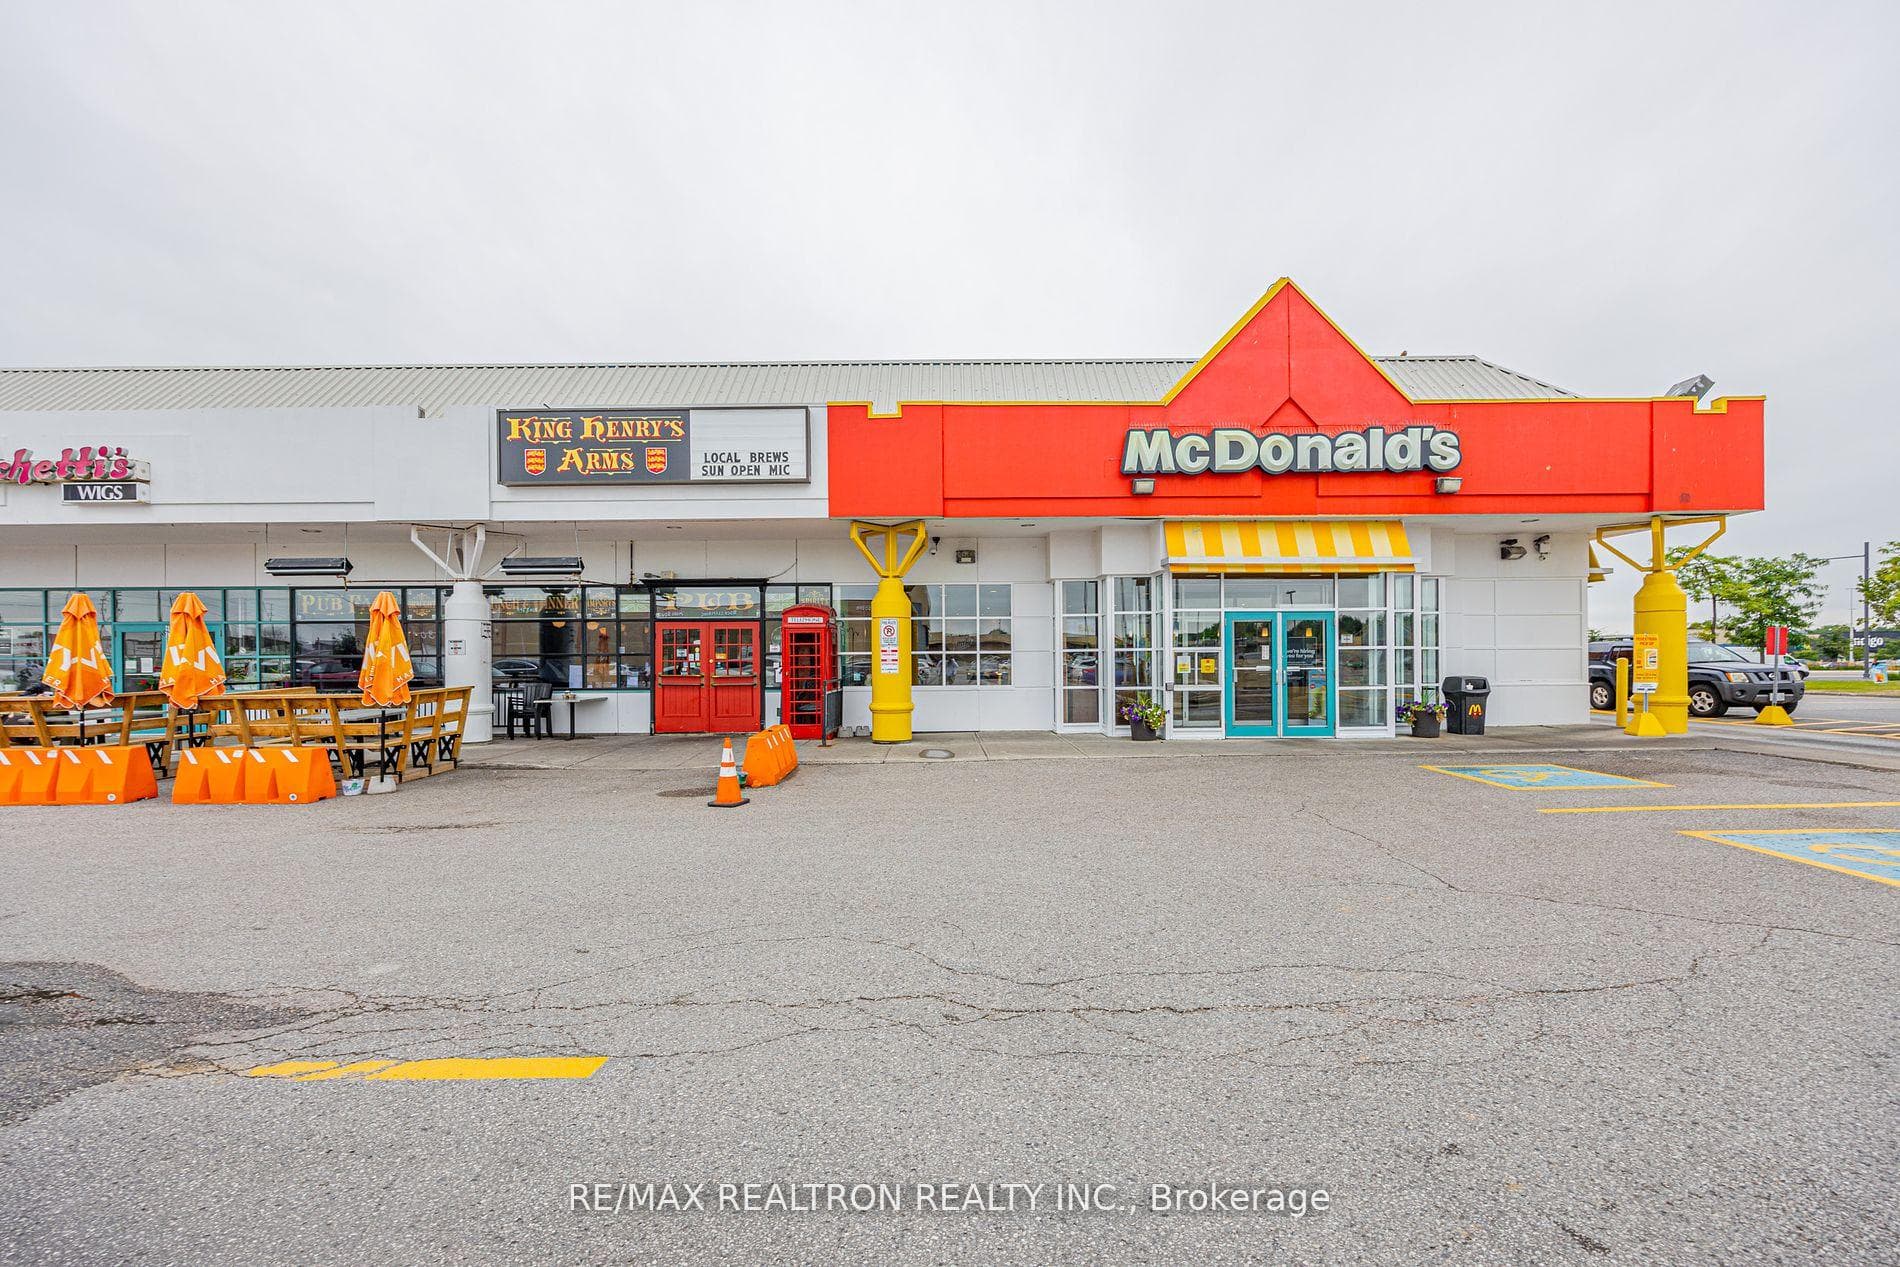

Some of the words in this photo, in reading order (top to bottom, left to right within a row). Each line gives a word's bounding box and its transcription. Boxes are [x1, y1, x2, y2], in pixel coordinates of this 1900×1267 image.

[704, 452, 741, 463] LOCAL
[750, 452, 789, 463] BREWS
[1123, 428, 1462, 473] McDonald's
[556, 447, 635, 475] ARMS
[702, 465, 724, 476] SUN
[731, 465, 760, 476] OPEN
[769, 464, 790, 476] MIC
[77, 485, 123, 500] WIGS
[302, 594, 343, 614] PUB
[662, 592, 754, 611] PUB
